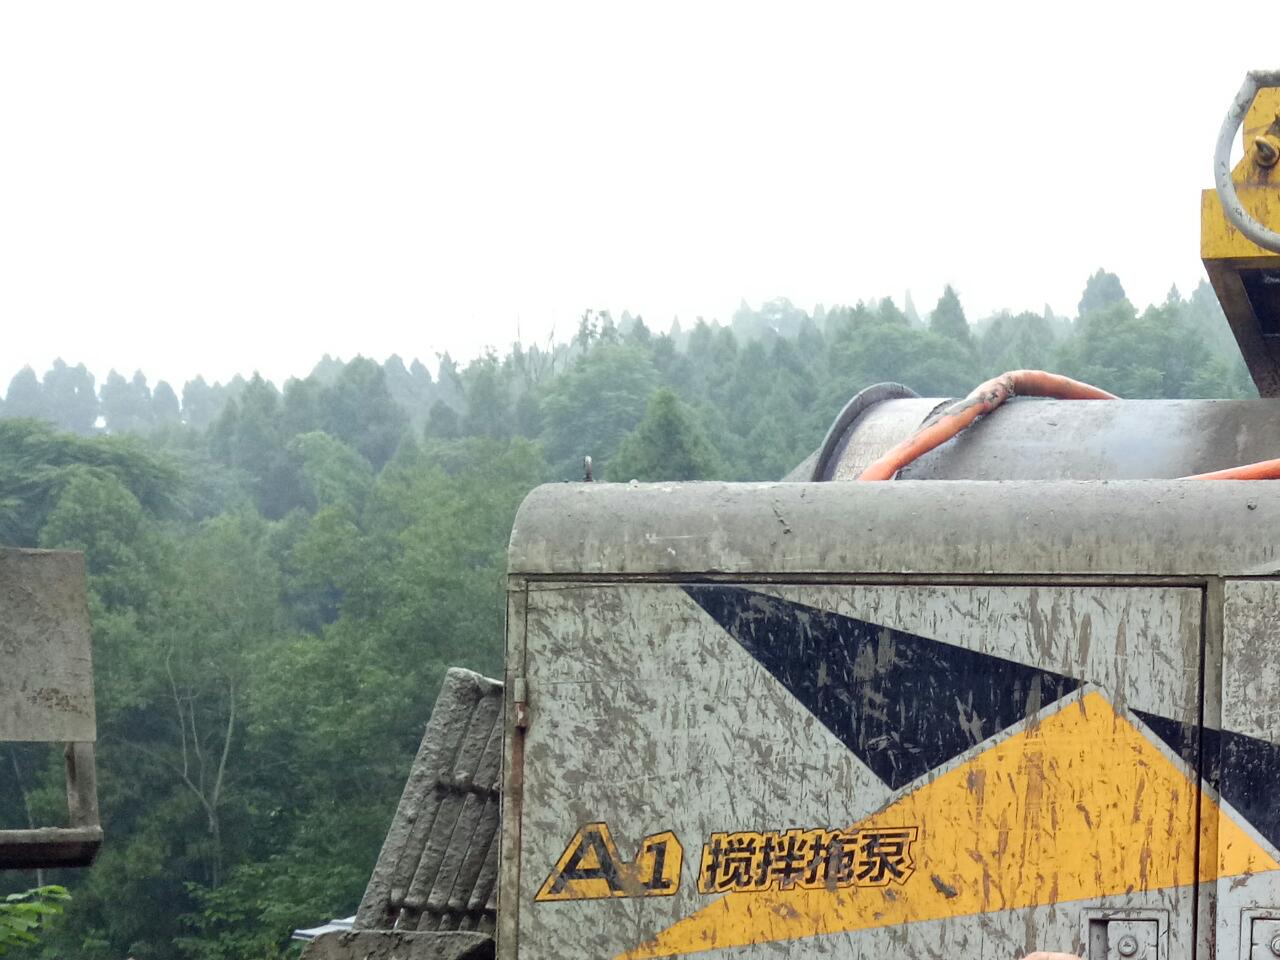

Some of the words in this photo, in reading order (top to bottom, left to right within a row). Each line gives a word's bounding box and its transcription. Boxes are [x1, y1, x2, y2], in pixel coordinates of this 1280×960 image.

[542, 826, 678, 897] A1
[702, 829, 916, 890] 搅拌拖泵
